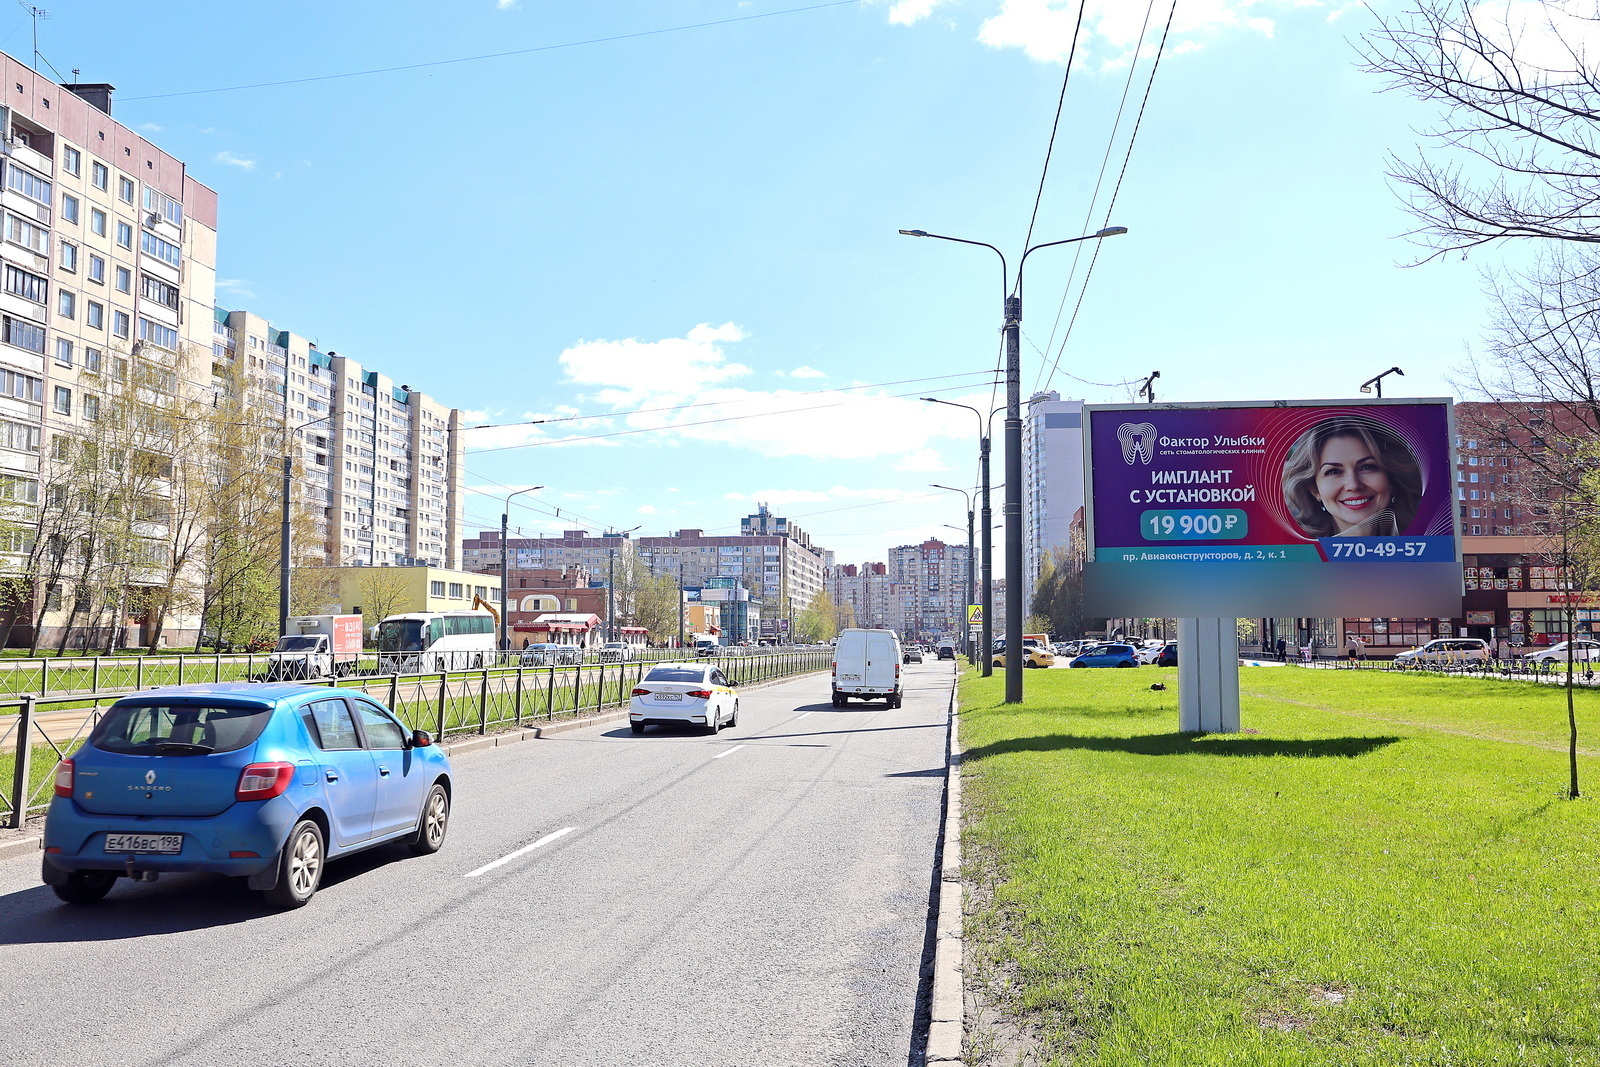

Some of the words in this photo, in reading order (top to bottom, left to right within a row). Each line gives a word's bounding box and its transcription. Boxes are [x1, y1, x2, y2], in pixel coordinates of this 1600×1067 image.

[1159, 436, 1209, 449] Фактор
[1214, 435, 1266, 447] Улыбки
[1151, 470, 1233, 485] ИМПЛАНТ
[1129, 489, 1141, 504] С
[1144, 484, 1256, 503] УСТАНОВКОЙ
[1150, 515, 1175, 535] 19
[1123, 553, 1138, 562] пр.
[1141, 551, 1242, 562] Авиаконструкторов,
[1244, 551, 1254, 560] д.
[1256, 550, 1266, 560] 2,
[1268, 551, 1277, 559] к.
[1280, 550, 1286, 559] 1
[1332, 542, 1427, 557] 770-49-57
